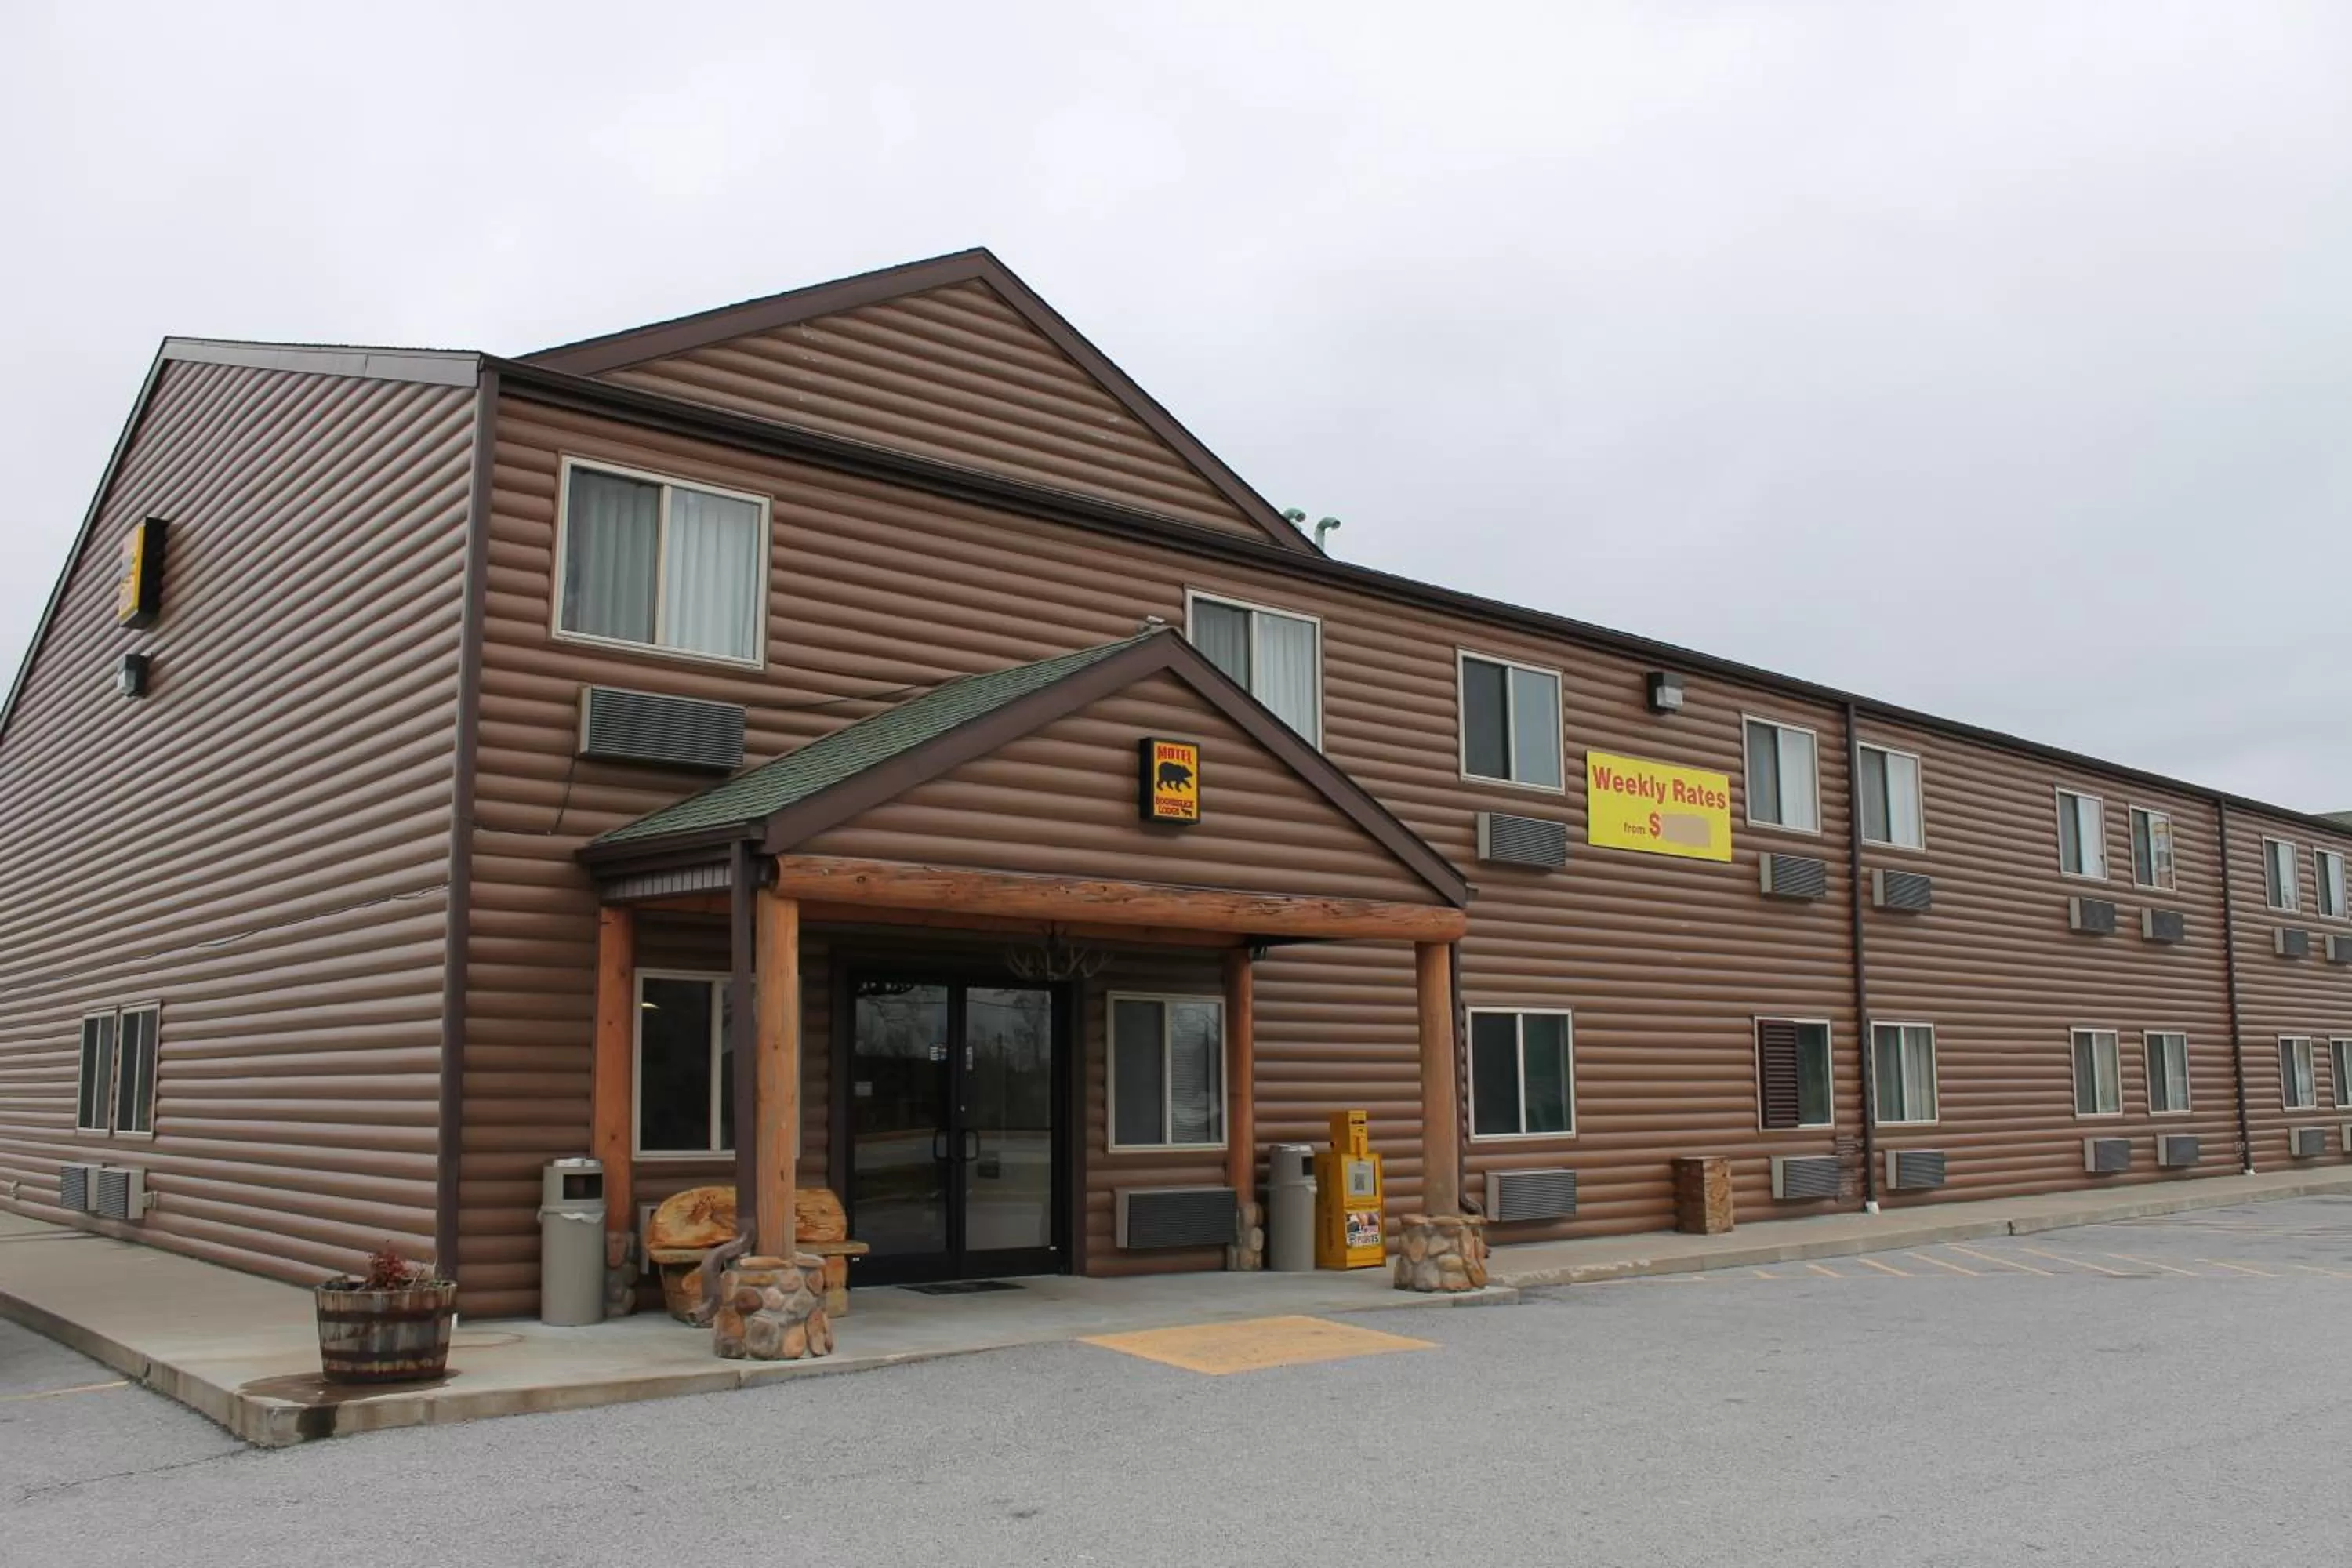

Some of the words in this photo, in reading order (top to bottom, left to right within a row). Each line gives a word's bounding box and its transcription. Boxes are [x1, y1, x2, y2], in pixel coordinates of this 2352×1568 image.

[1157, 746, 1192, 764] MOTEL
[1592, 764, 1666, 805] Weekly
[1672, 777, 1726, 810] Rates
[1624, 821, 1646, 835] from
